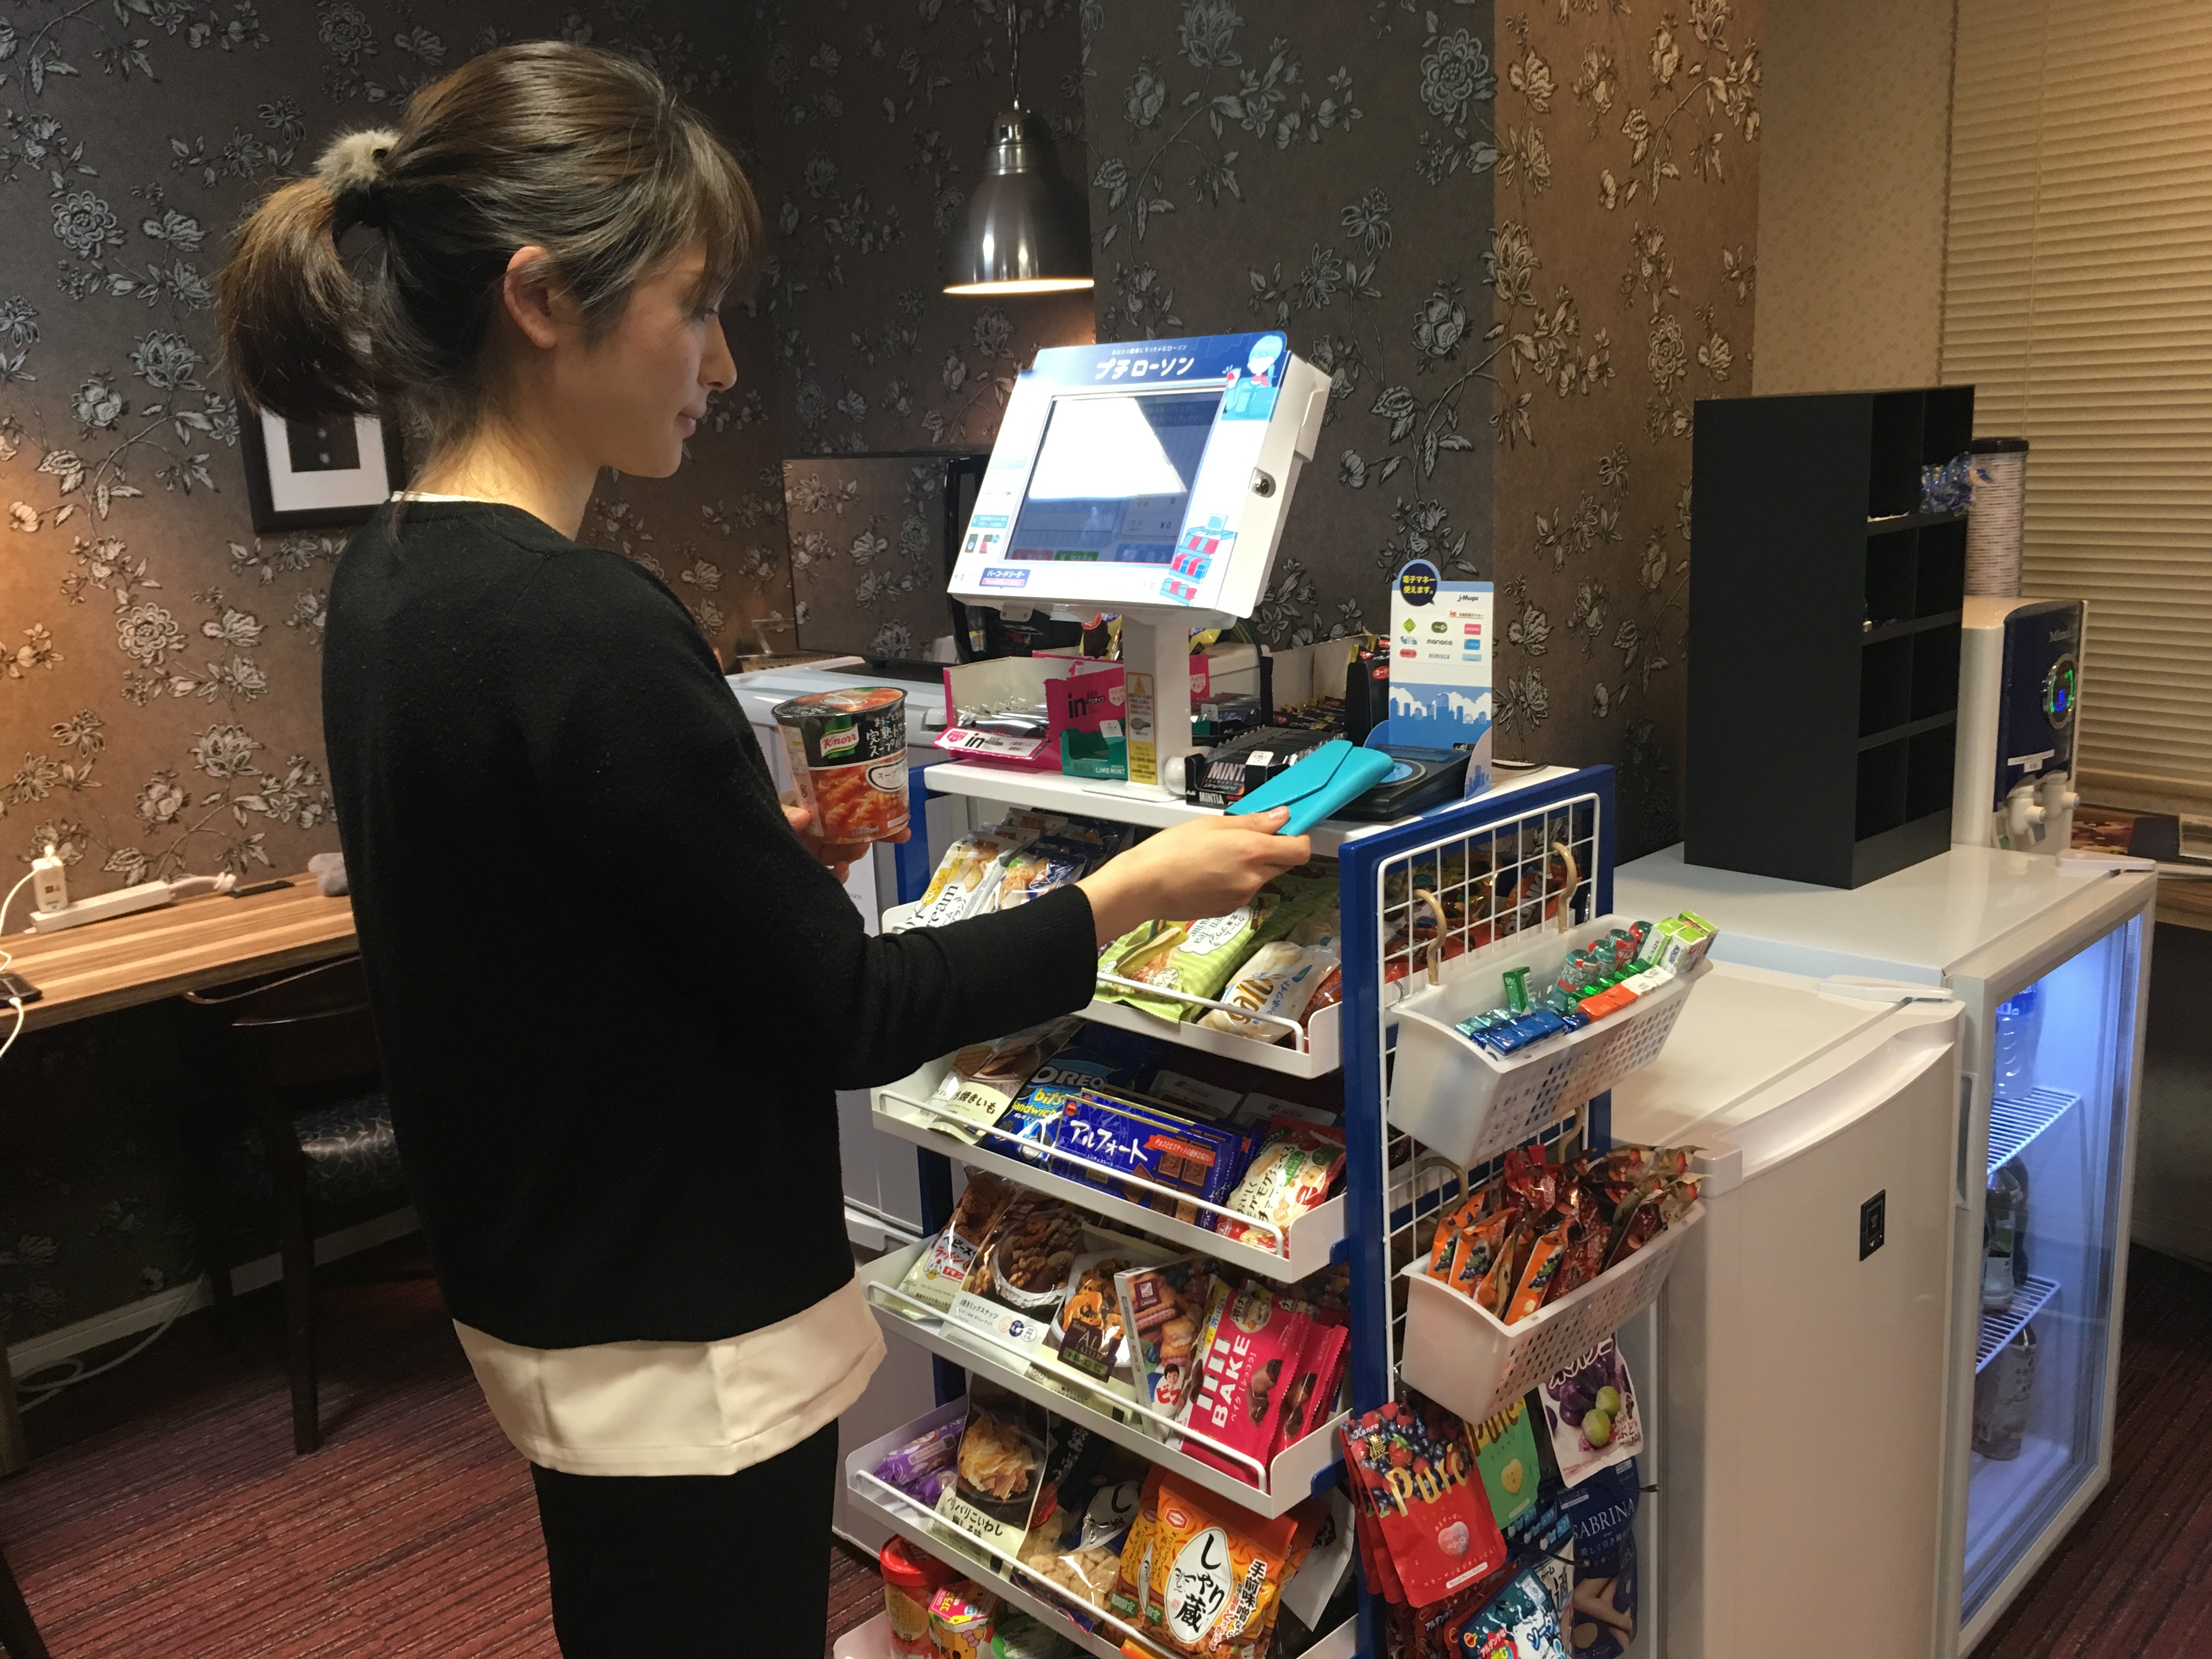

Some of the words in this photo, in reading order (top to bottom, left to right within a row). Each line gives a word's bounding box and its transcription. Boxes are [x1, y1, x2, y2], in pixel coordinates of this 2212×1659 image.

[1095, 358, 1194, 380] プチローソン
[1402, 575, 1436, 584] 電子マネー
[1403, 585, 1434, 594] 使えます。
[1067, 693, 1087, 719] in
[823, 731, 858, 750] Knorr
[964, 733, 985, 748] in
[1207, 761, 1245, 782] MINT
[1199, 791, 1224, 805] MINTIA
[1031, 1066, 1104, 1091] OREO
[1034, 1087, 1066, 1105] bits
[1070, 1120, 1148, 1164] アルフォート
[1237, 1181, 1258, 1214] おいしく
[945, 1267, 963, 1278] チキン
[1141, 1299, 1158, 1307] LAWSON
[1211, 1335, 1251, 1428] BAKE
[1231, 1396, 1241, 1422] ベイク
[1353, 1423, 1379, 1438] Kanro
[1572, 1498, 1635, 1540] SABRINA
[1174, 1533, 1225, 1633] しゃり蔵
